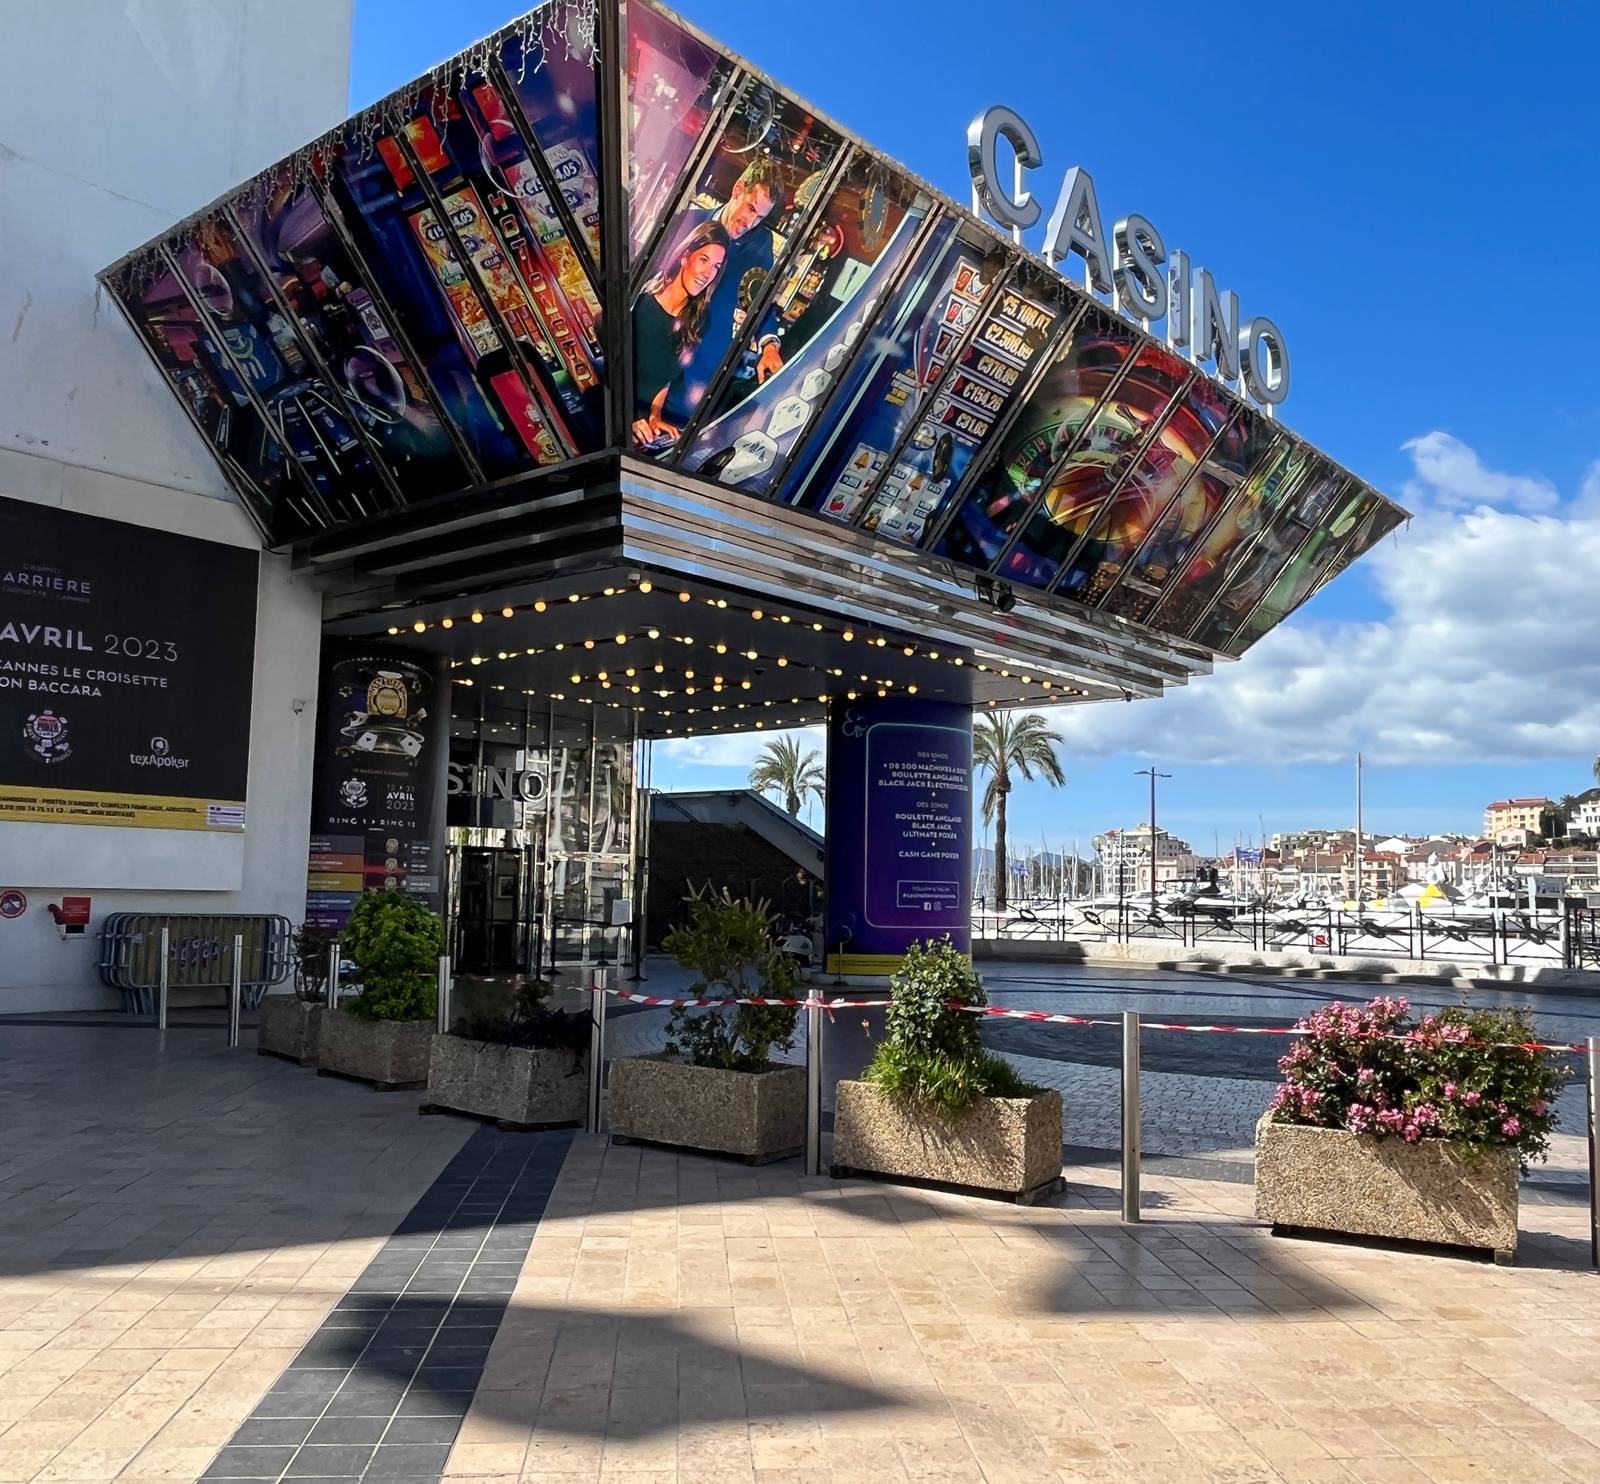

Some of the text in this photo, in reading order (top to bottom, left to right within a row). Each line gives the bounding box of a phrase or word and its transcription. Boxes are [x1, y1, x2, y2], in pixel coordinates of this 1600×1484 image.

[967, 105, 1290, 406] CASINO
[0, 622, 178, 662] AVRIL 2023
[0, 660, 168, 688] ANNES LE CROISETTE
[29, 680, 102, 697] BACCARA
[892, 771, 931, 779] ROULETTE
[879, 779, 905, 787] BLACK
[906, 780, 925, 788] JACK
[386, 792, 415, 801] AVRIL
[895, 813, 934, 821] ROULETTE
[329, 817, 358, 825] RING
[380, 819, 404, 827] RING
[912, 822, 952, 831] BLACK JACK
[903, 831, 937, 839] ULTIMATE
[920, 851, 940, 859] GAME
